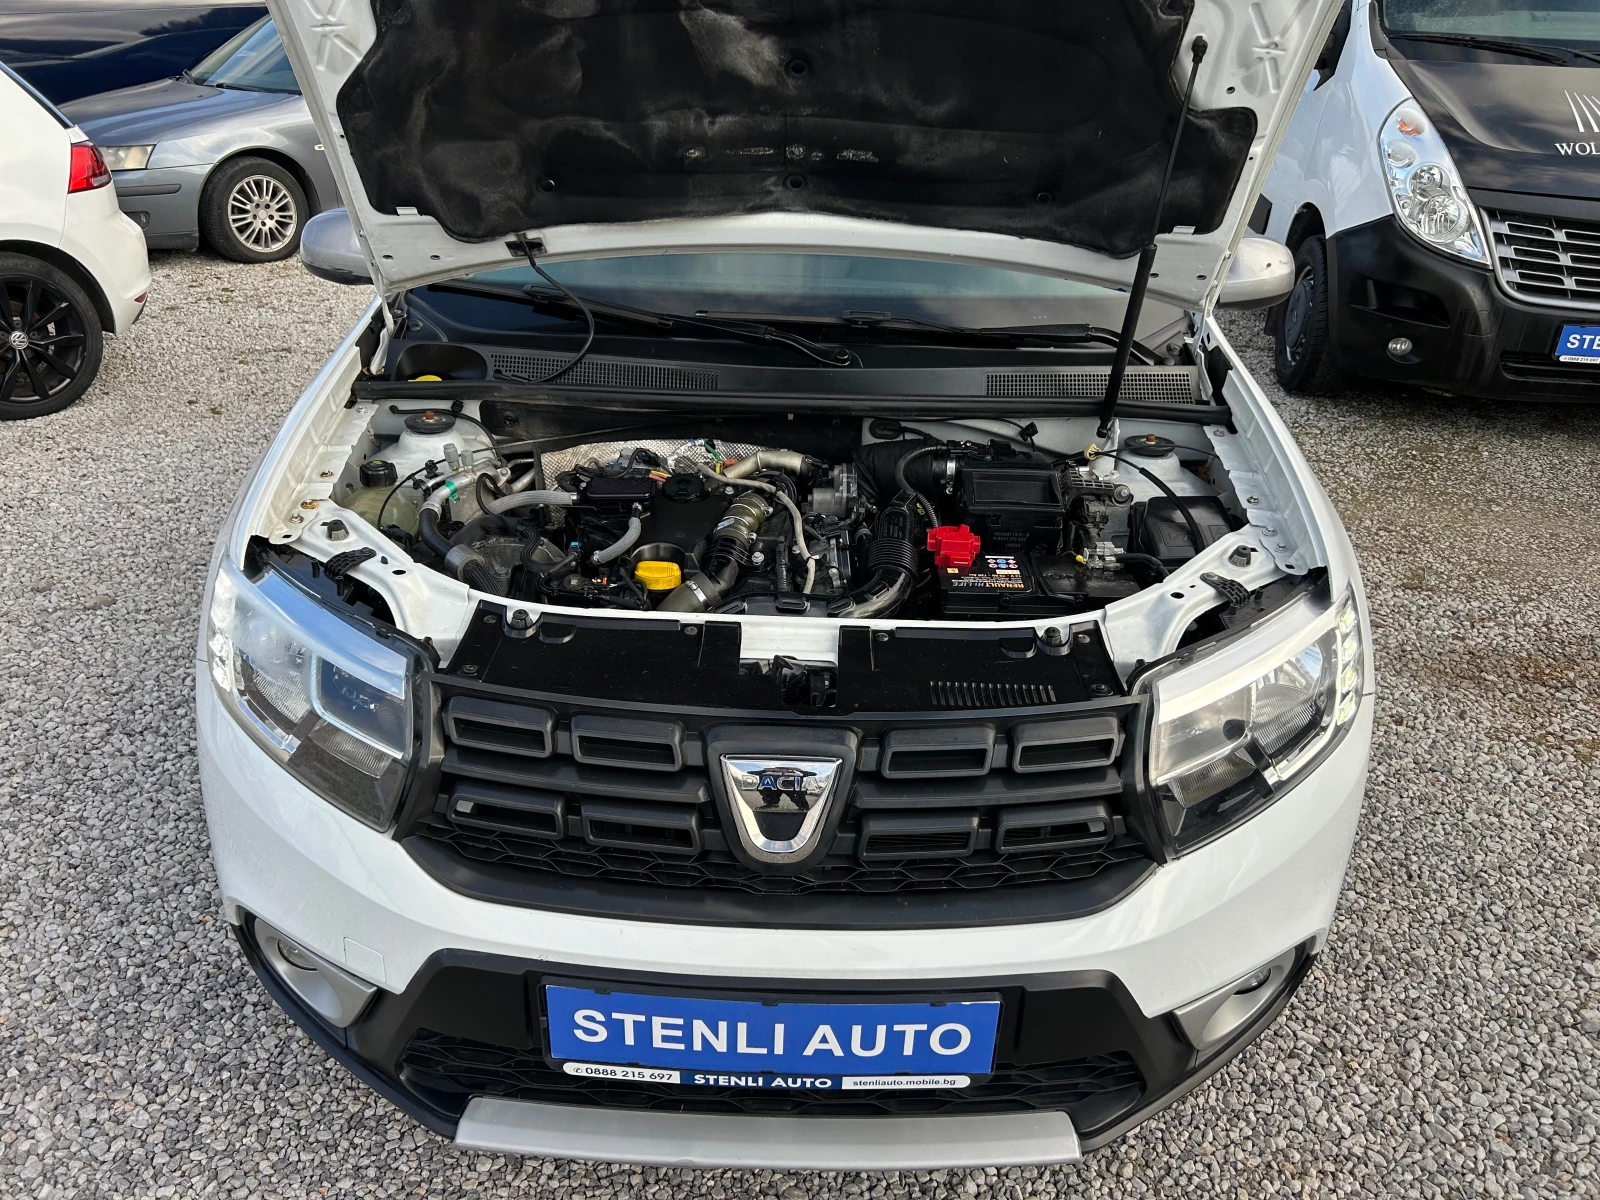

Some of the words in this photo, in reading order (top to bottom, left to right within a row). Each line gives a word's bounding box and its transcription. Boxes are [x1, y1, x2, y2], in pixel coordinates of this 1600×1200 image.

[1554, 142, 1600, 156] WOL
[741, 774, 819, 792] DACIA
[572, 1009, 785, 1055] STENLI
[802, 1023, 972, 1057] AUTO
[585, 1067, 617, 1077] 0888
[621, 1070, 645, 1079] 215
[649, 1072, 673, 1081] 697
[693, 1074, 764, 1087] STENLI
[770, 1077, 832, 1088] AUTO
[852, 1079, 956, 1087] stenliauto.mobile.bg
